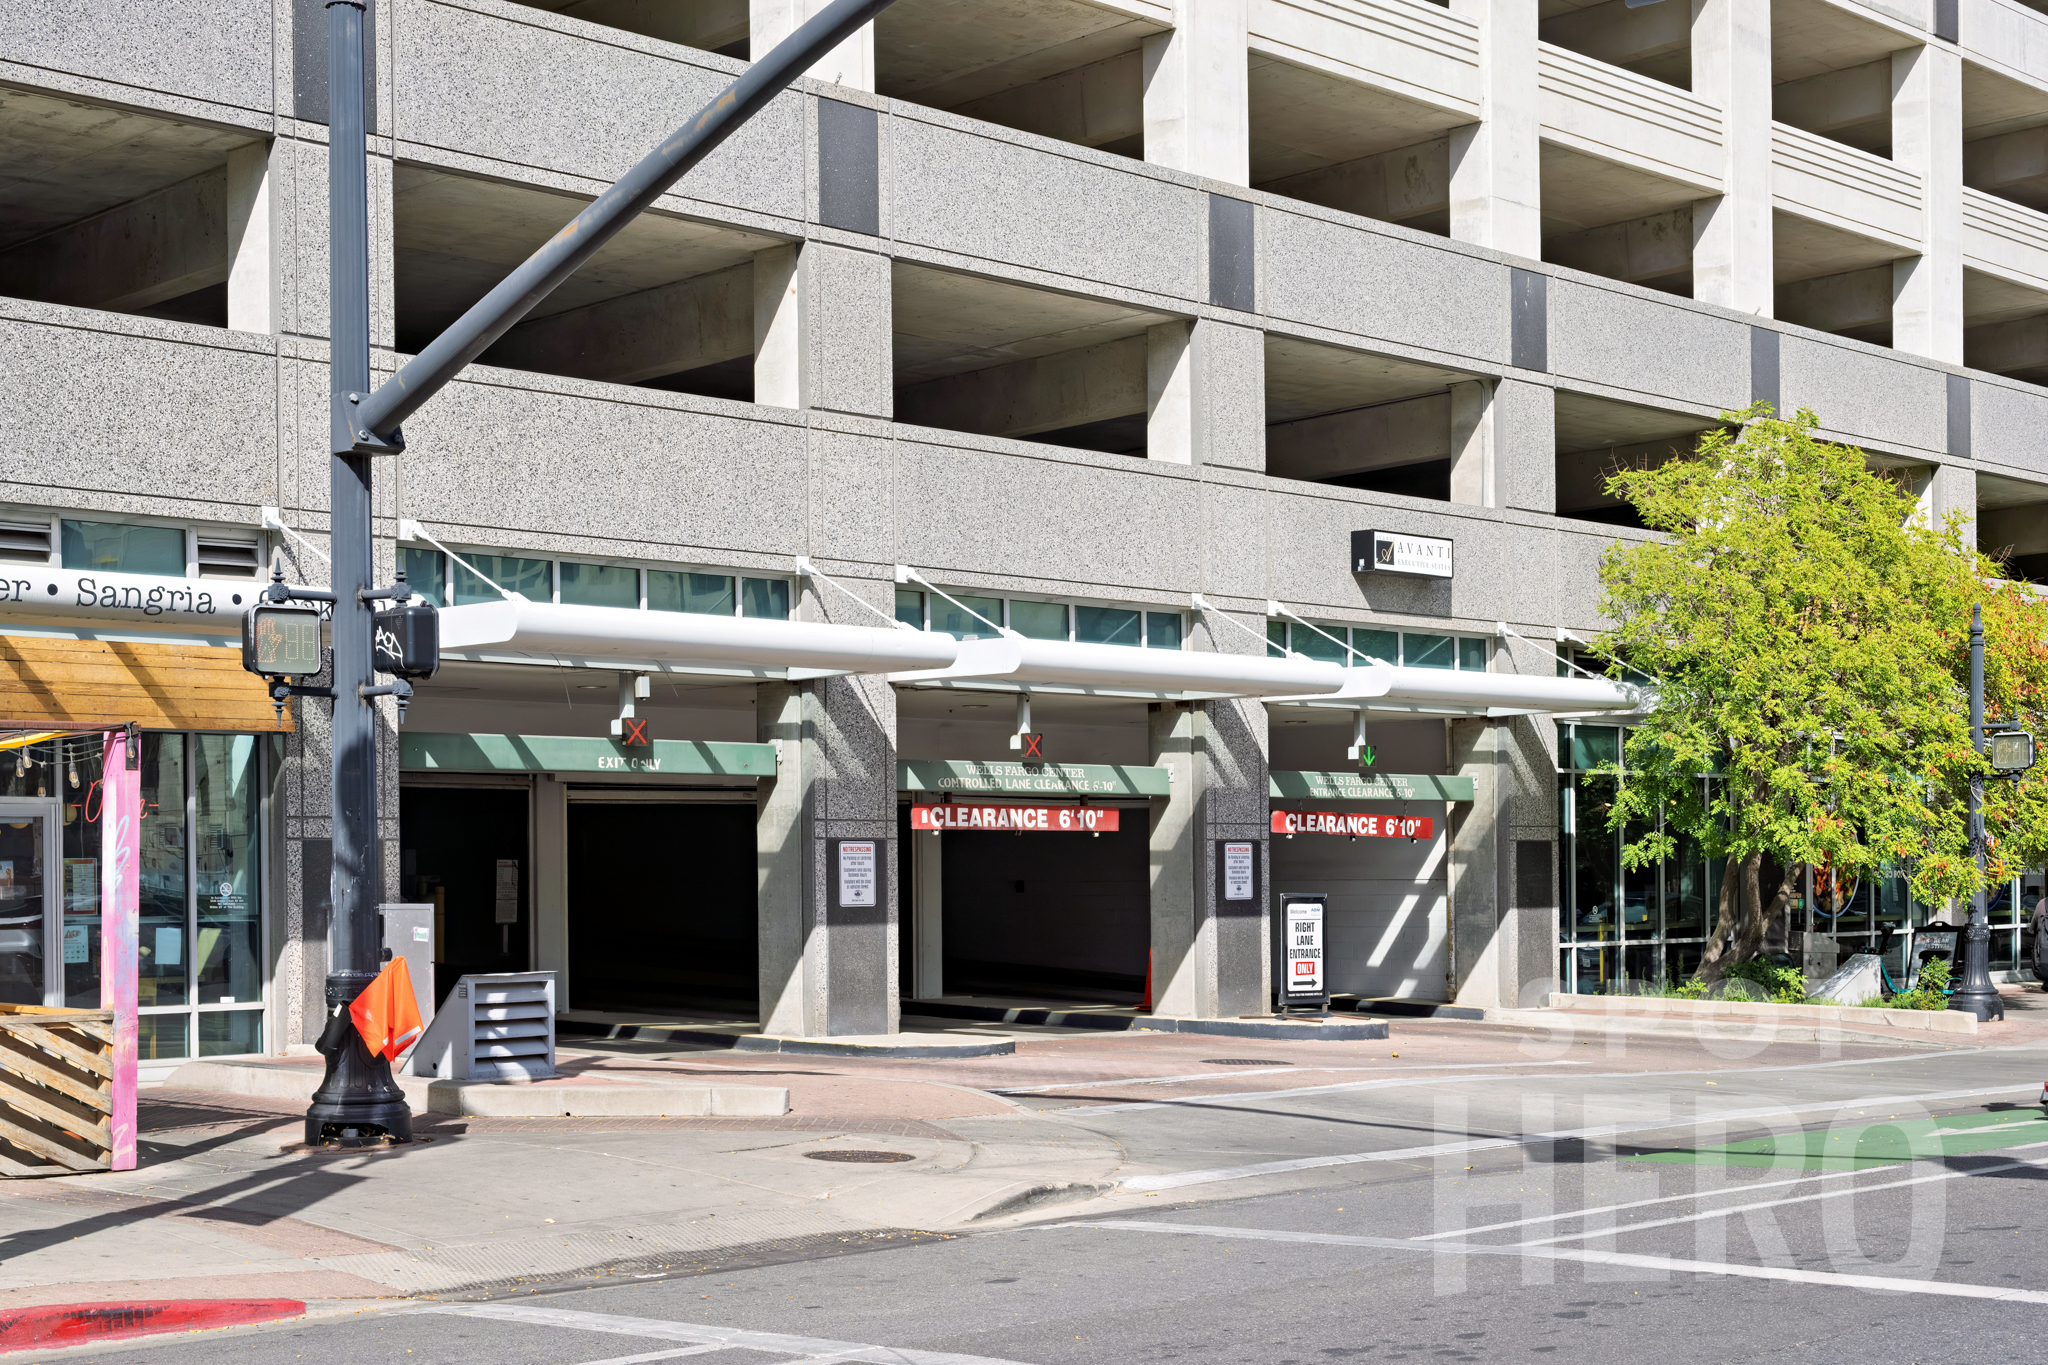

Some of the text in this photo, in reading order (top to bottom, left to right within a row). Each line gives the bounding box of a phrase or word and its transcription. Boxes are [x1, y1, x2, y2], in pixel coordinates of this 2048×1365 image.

[1397, 541, 1450, 559] AVANTI
[1397, 559, 1451, 571] EXECUTIVE SUITES
[76, 577, 217, 616] Sangria
[598, 756, 661, 770] EXIT ONLY
[965, 764, 1085, 779] WELLS FARGO CENTER
[938, 777, 1002, 789] CONTROLLED
[1005, 778, 1031, 790] LANE
[1034, 779, 1090, 791] CLEARANCE
[1315, 775, 1408, 787] WELLS FARGO CENTER
[1310, 787, 1346, 797] ENTRANCE
[1347, 788, 1393, 798] CLEARANCE
[930, 807, 1049, 828] CLEARANCE
[1285, 813, 1378, 835] CLEARANCE
[1295, 922, 1315, 933] RIGHT
[1296, 935, 1314, 946] LANE
[1289, 948, 1321, 959] ENTRANCE
[1297, 962, 1313, 975] ONLY
